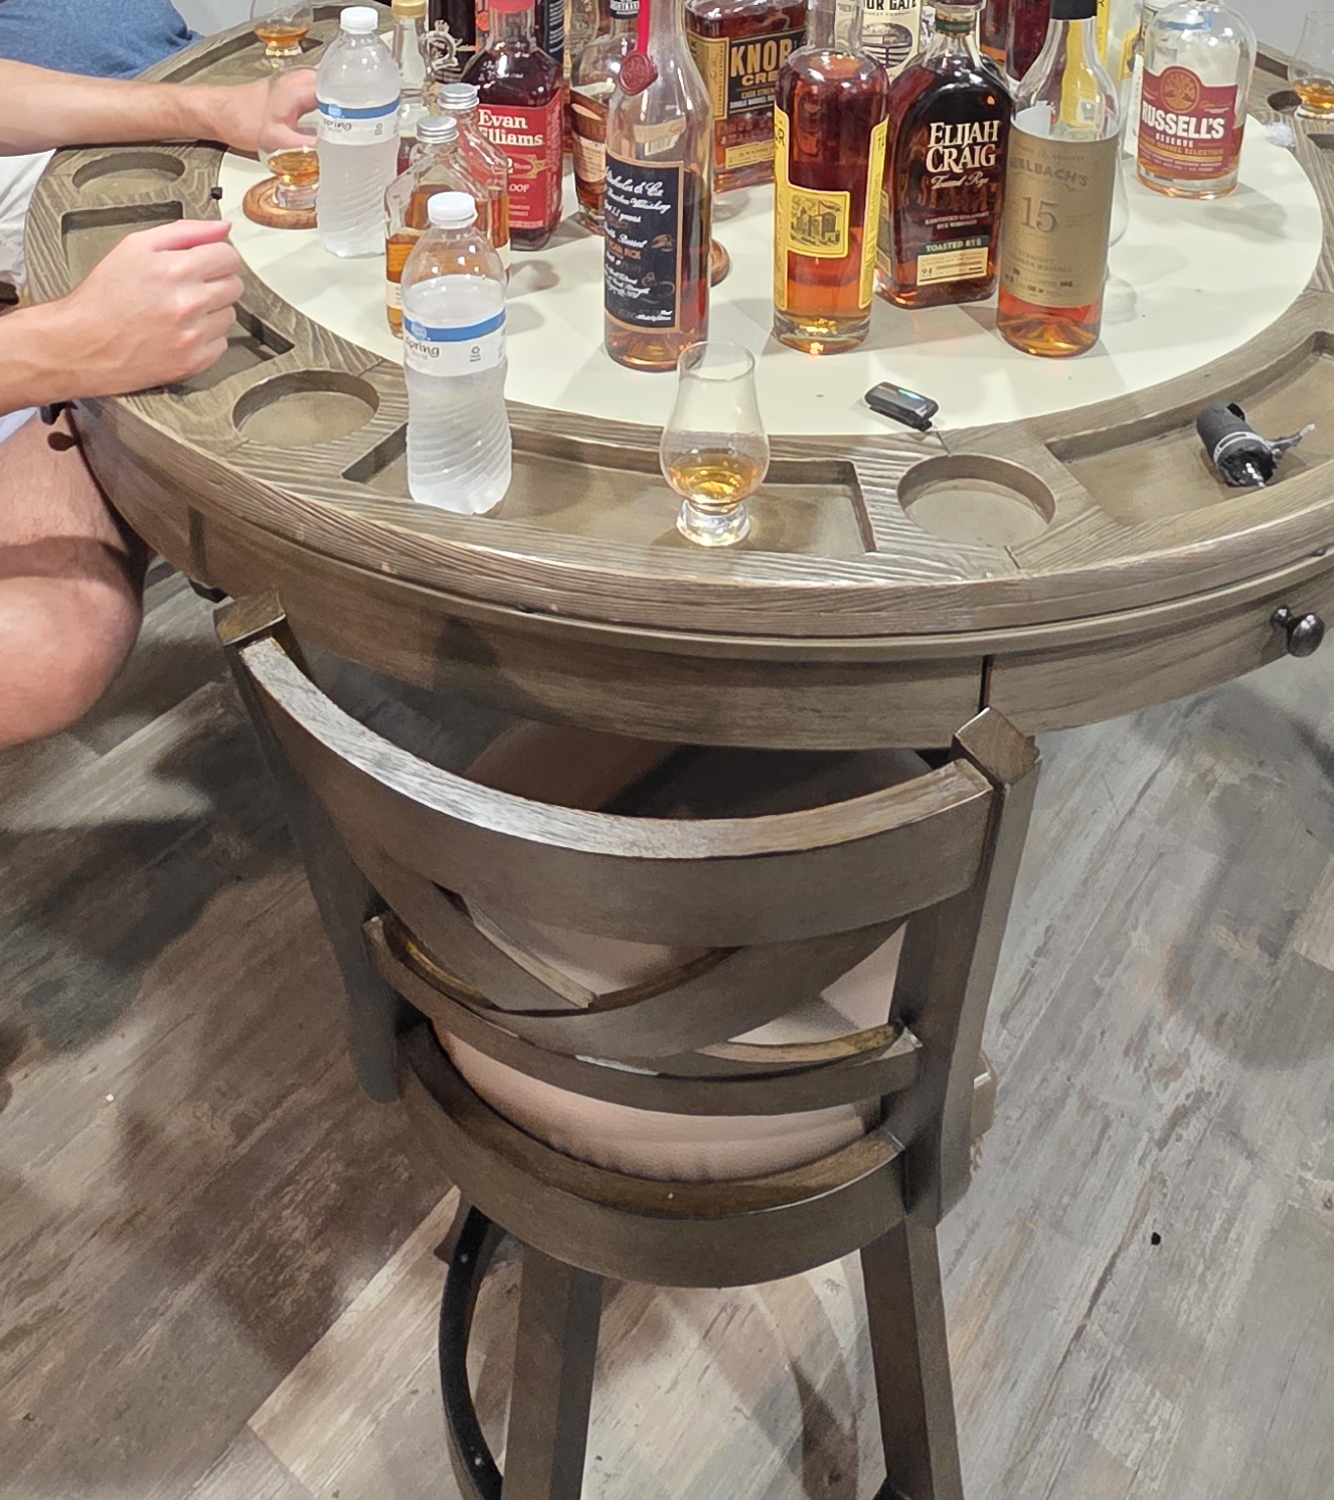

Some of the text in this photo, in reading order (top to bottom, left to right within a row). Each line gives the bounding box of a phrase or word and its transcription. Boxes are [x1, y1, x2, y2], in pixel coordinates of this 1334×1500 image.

[741, 70, 778, 87] CRE
[478, 109, 528, 129] Evan
[1141, 100, 1225, 139] RUSSELL'S
[927, 119, 1000, 149] ELIJAH
[926, 143, 996, 173] CRAIG
[508, 184, 530, 193] OOF
[1020, 197, 1058, 233] 15
[926, 240, 964, 252] TOASTED
